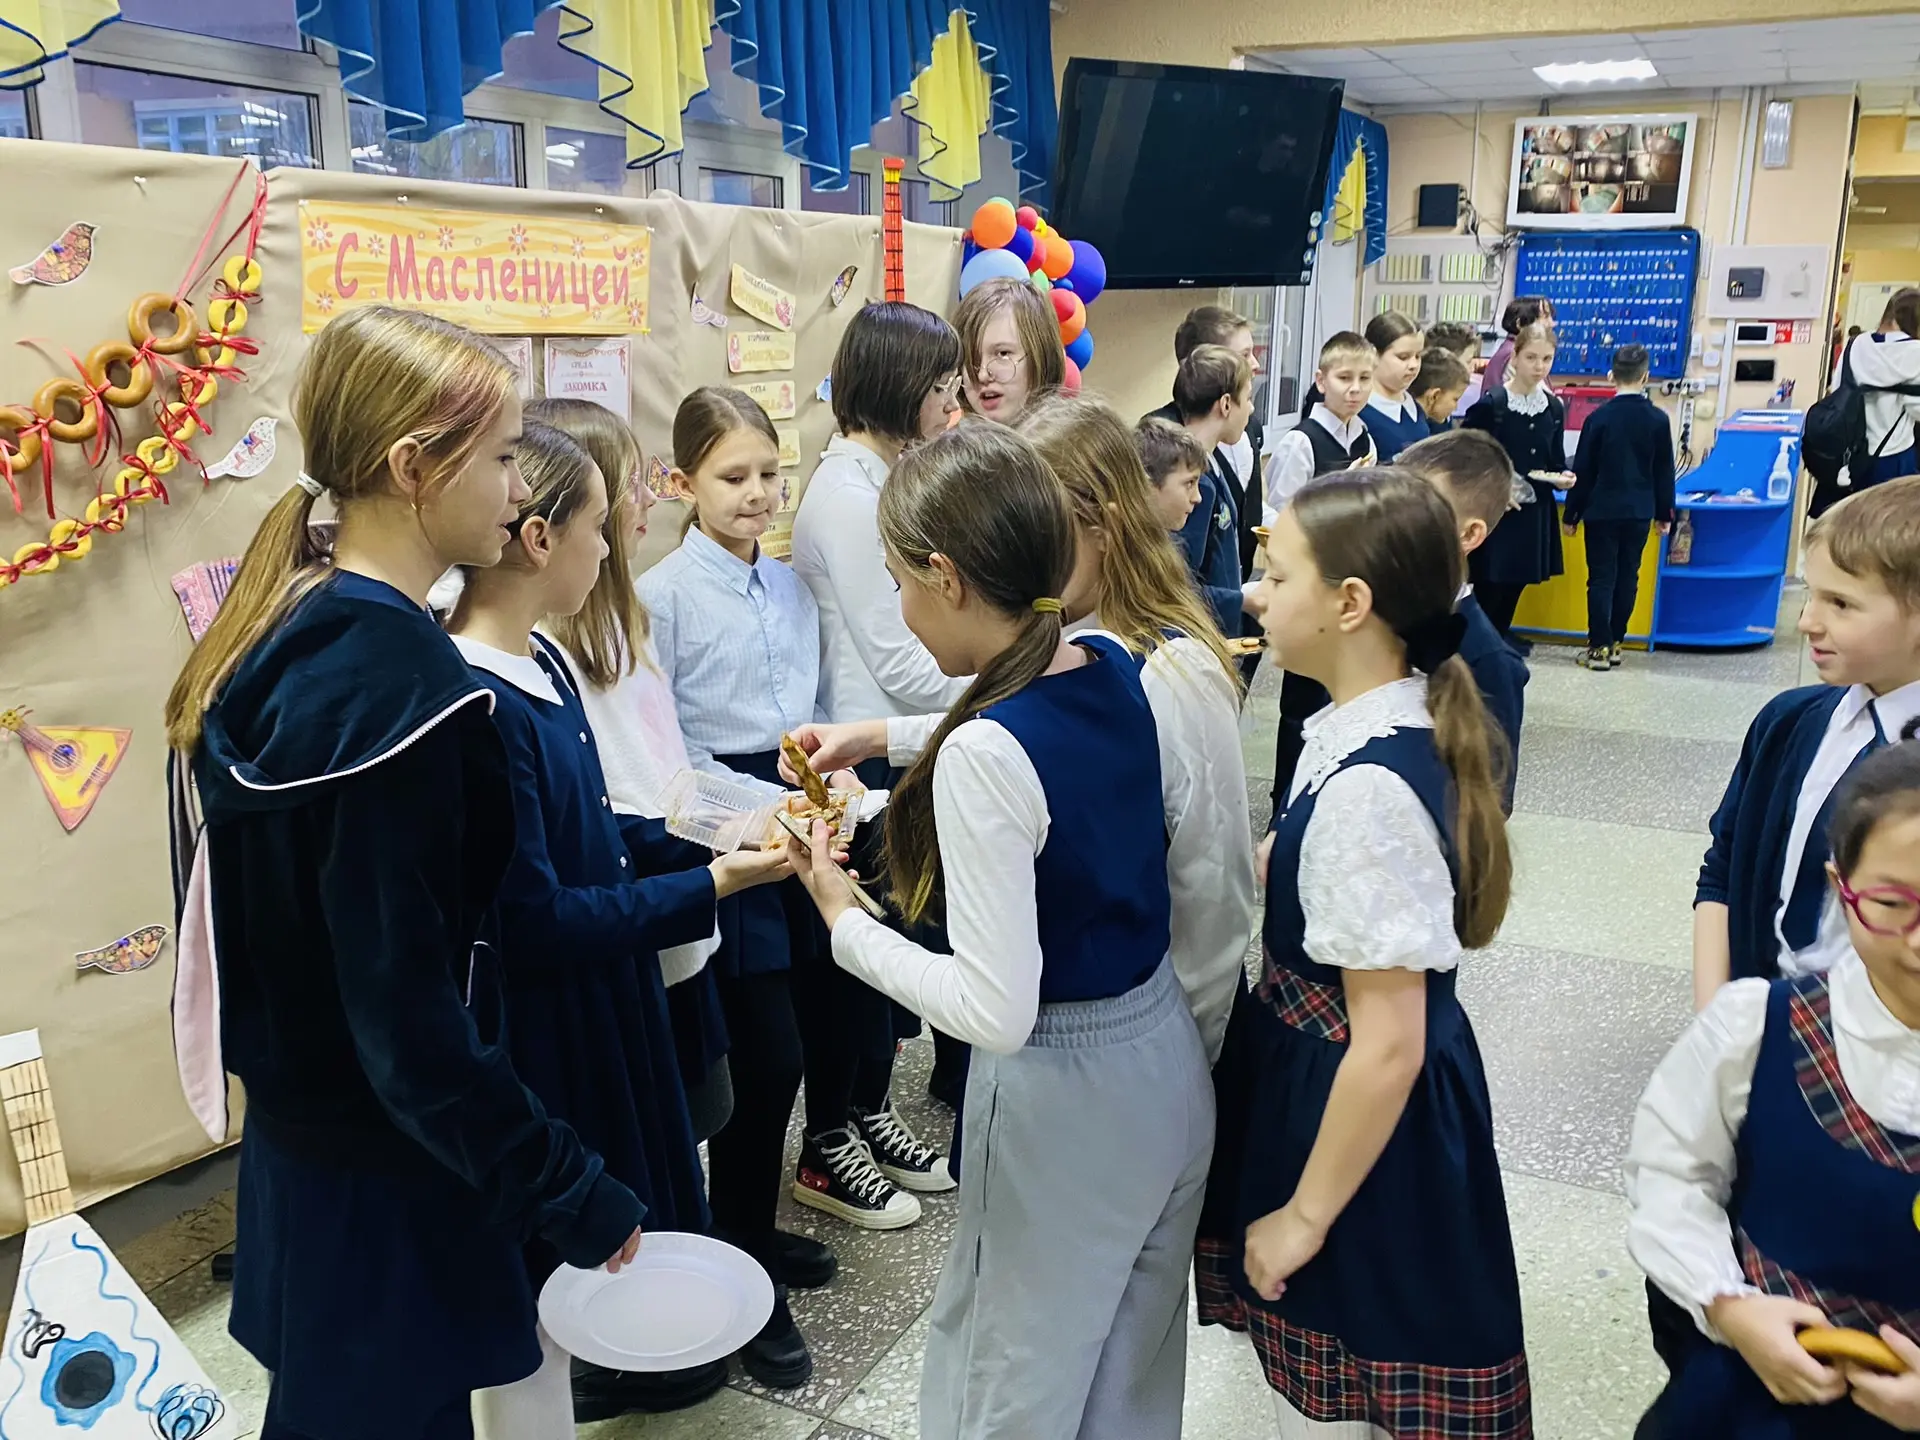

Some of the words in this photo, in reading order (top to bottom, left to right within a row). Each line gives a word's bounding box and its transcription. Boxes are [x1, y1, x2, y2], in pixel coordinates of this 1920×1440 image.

[335, 232, 359, 299] С
[386, 233, 630, 313] Масленицей
[562, 381, 608, 393] ЛАКОМКА
